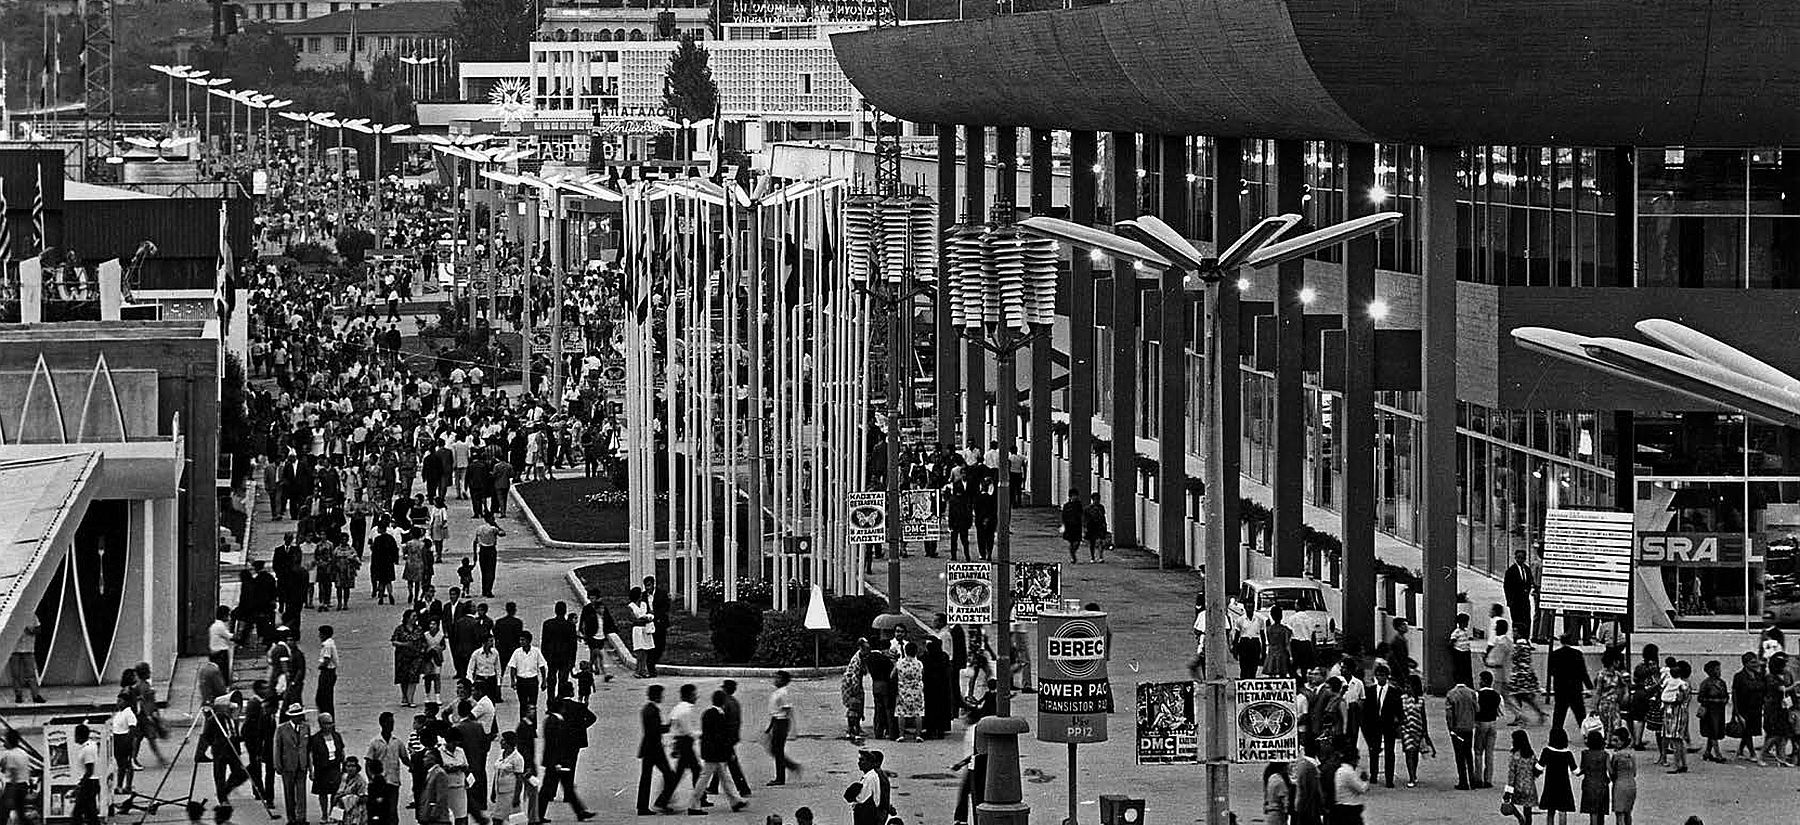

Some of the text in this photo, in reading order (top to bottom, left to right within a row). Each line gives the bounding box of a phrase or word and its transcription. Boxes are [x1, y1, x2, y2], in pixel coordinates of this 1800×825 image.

[904, 525, 926, 533] DMC
[1017, 603, 1043, 613] DMC
[949, 614, 990, 622] ΚΛΩΣΤΗ
[1049, 640, 1104, 657] BEREC
[1237, 681, 1294, 691] ΚΛΩΣΤΑΙ
[1237, 691, 1295, 703] ΠΕΤΑΛΟΥΔΑΣ
[1045, 700, 1094, 712] TRANSISTOR
[1141, 737, 1175, 750] DMC
[1239, 737, 1296, 749] Η ΑΤΣΑΛΙΝΗ
[1239, 749, 1296, 761] ΚΛΩΣΤΗ
